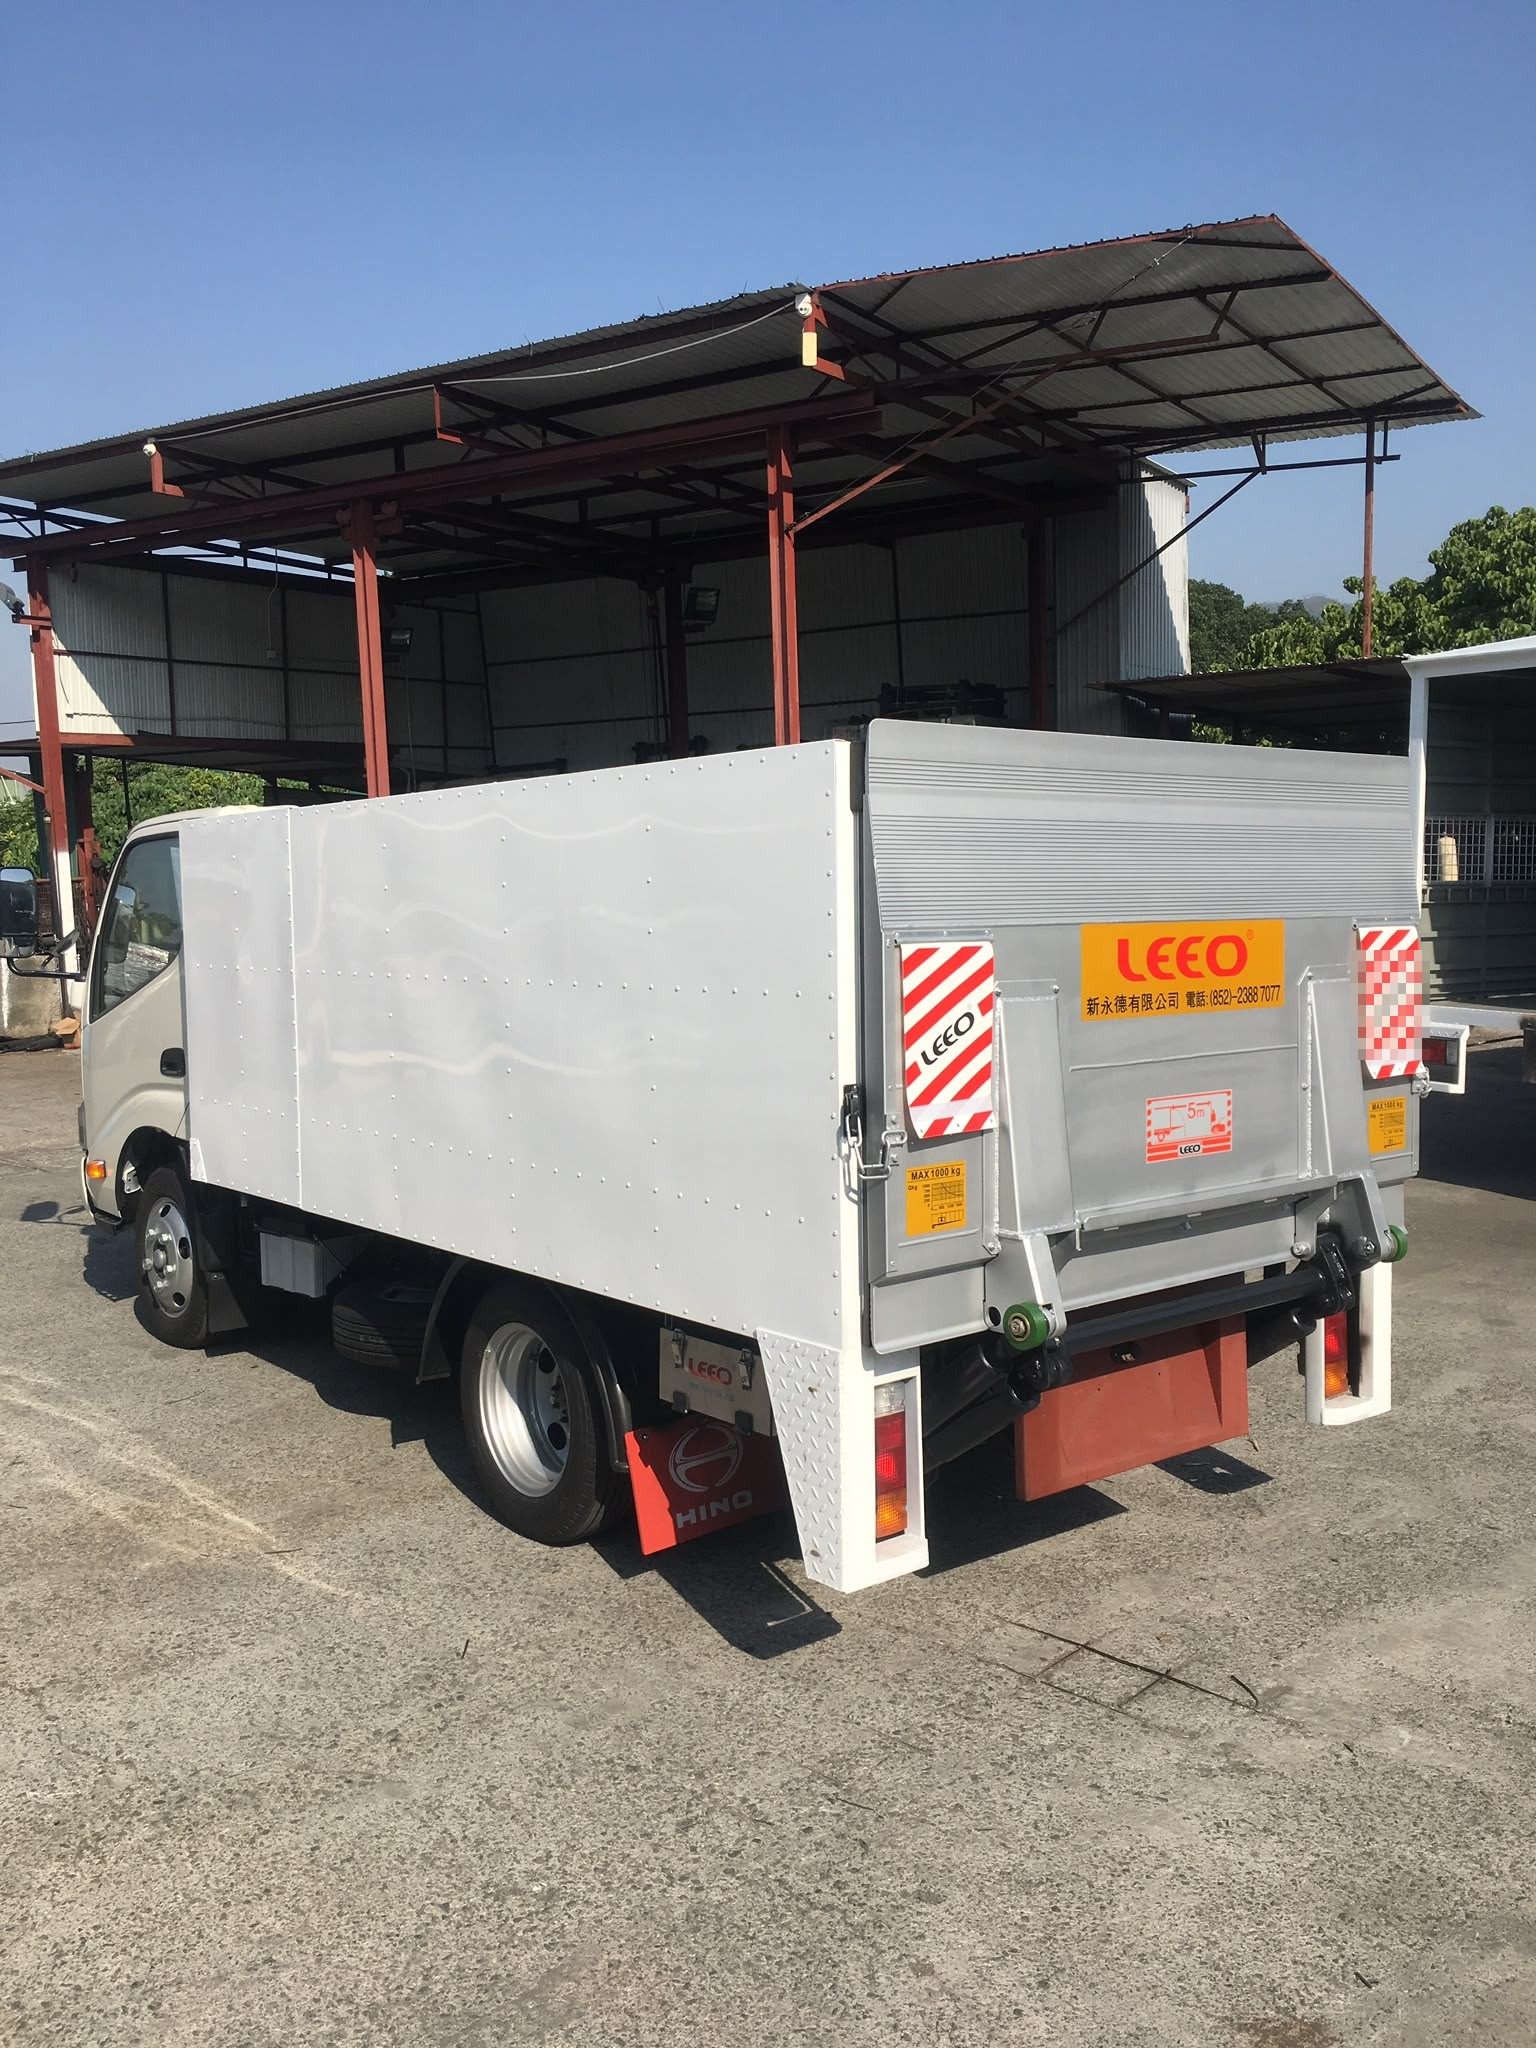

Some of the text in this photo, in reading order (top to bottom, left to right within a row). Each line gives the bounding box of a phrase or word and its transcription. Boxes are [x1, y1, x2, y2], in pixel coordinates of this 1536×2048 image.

[1117, 935, 1248, 982] LEEO
[1086, 991, 1180, 1017] 新永德有限公司
[1260, 985, 1281, 1002] 7077
[921, 1011, 975, 1066] LEEO
[1179, 1144, 1201, 1155] LEEO
[911, 1166, 961, 1181] MAX 1000 kg
[688, 1357, 733, 1386] LEEO
[675, 1488, 753, 1530] HINO
